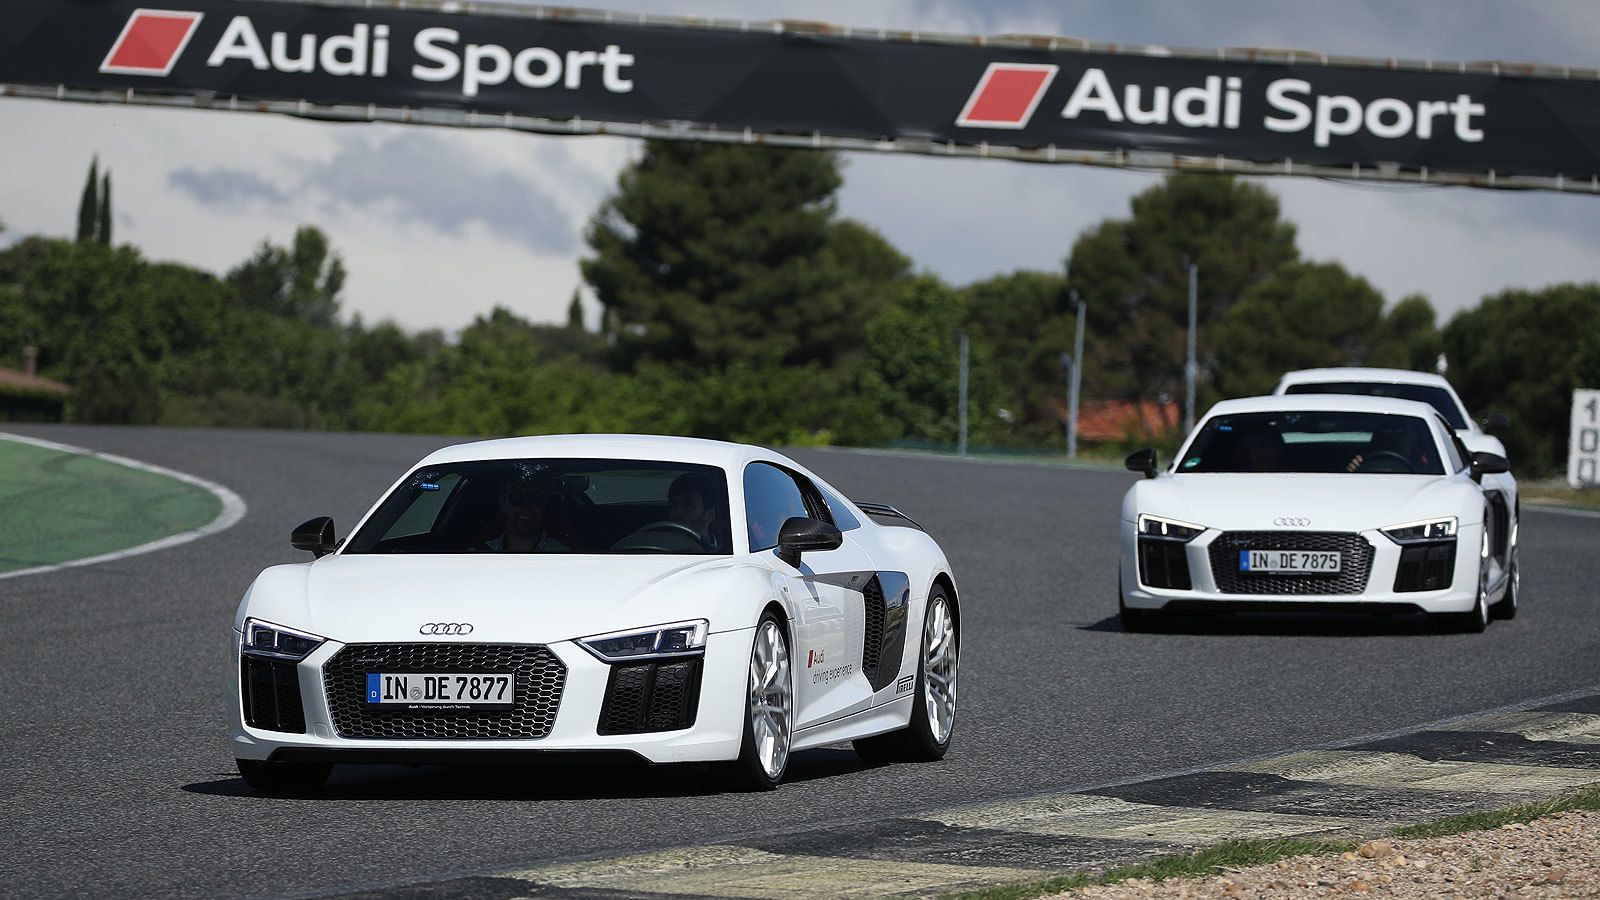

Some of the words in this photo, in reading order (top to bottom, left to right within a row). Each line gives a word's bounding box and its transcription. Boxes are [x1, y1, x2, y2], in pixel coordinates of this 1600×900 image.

[207, 15, 391, 77] Audi
[411, 26, 635, 97] Sport
[1061, 68, 1242, 129] Audi
[1263, 78, 1486, 148] Sport
[1251, 552, 1269, 569] IN
[1279, 552, 1298, 569] DE
[1301, 553, 1338, 570] 7875
[813, 650, 825, 664] Audi
[813, 668, 829, 685] driving
[829, 663, 853, 682] experience
[896, 674, 914, 695] PIRELLI
[371, 690, 377, 698] D
[383, 676, 408, 700] IN
[423, 676, 451, 700] DE
[455, 676, 509, 700] 7877
